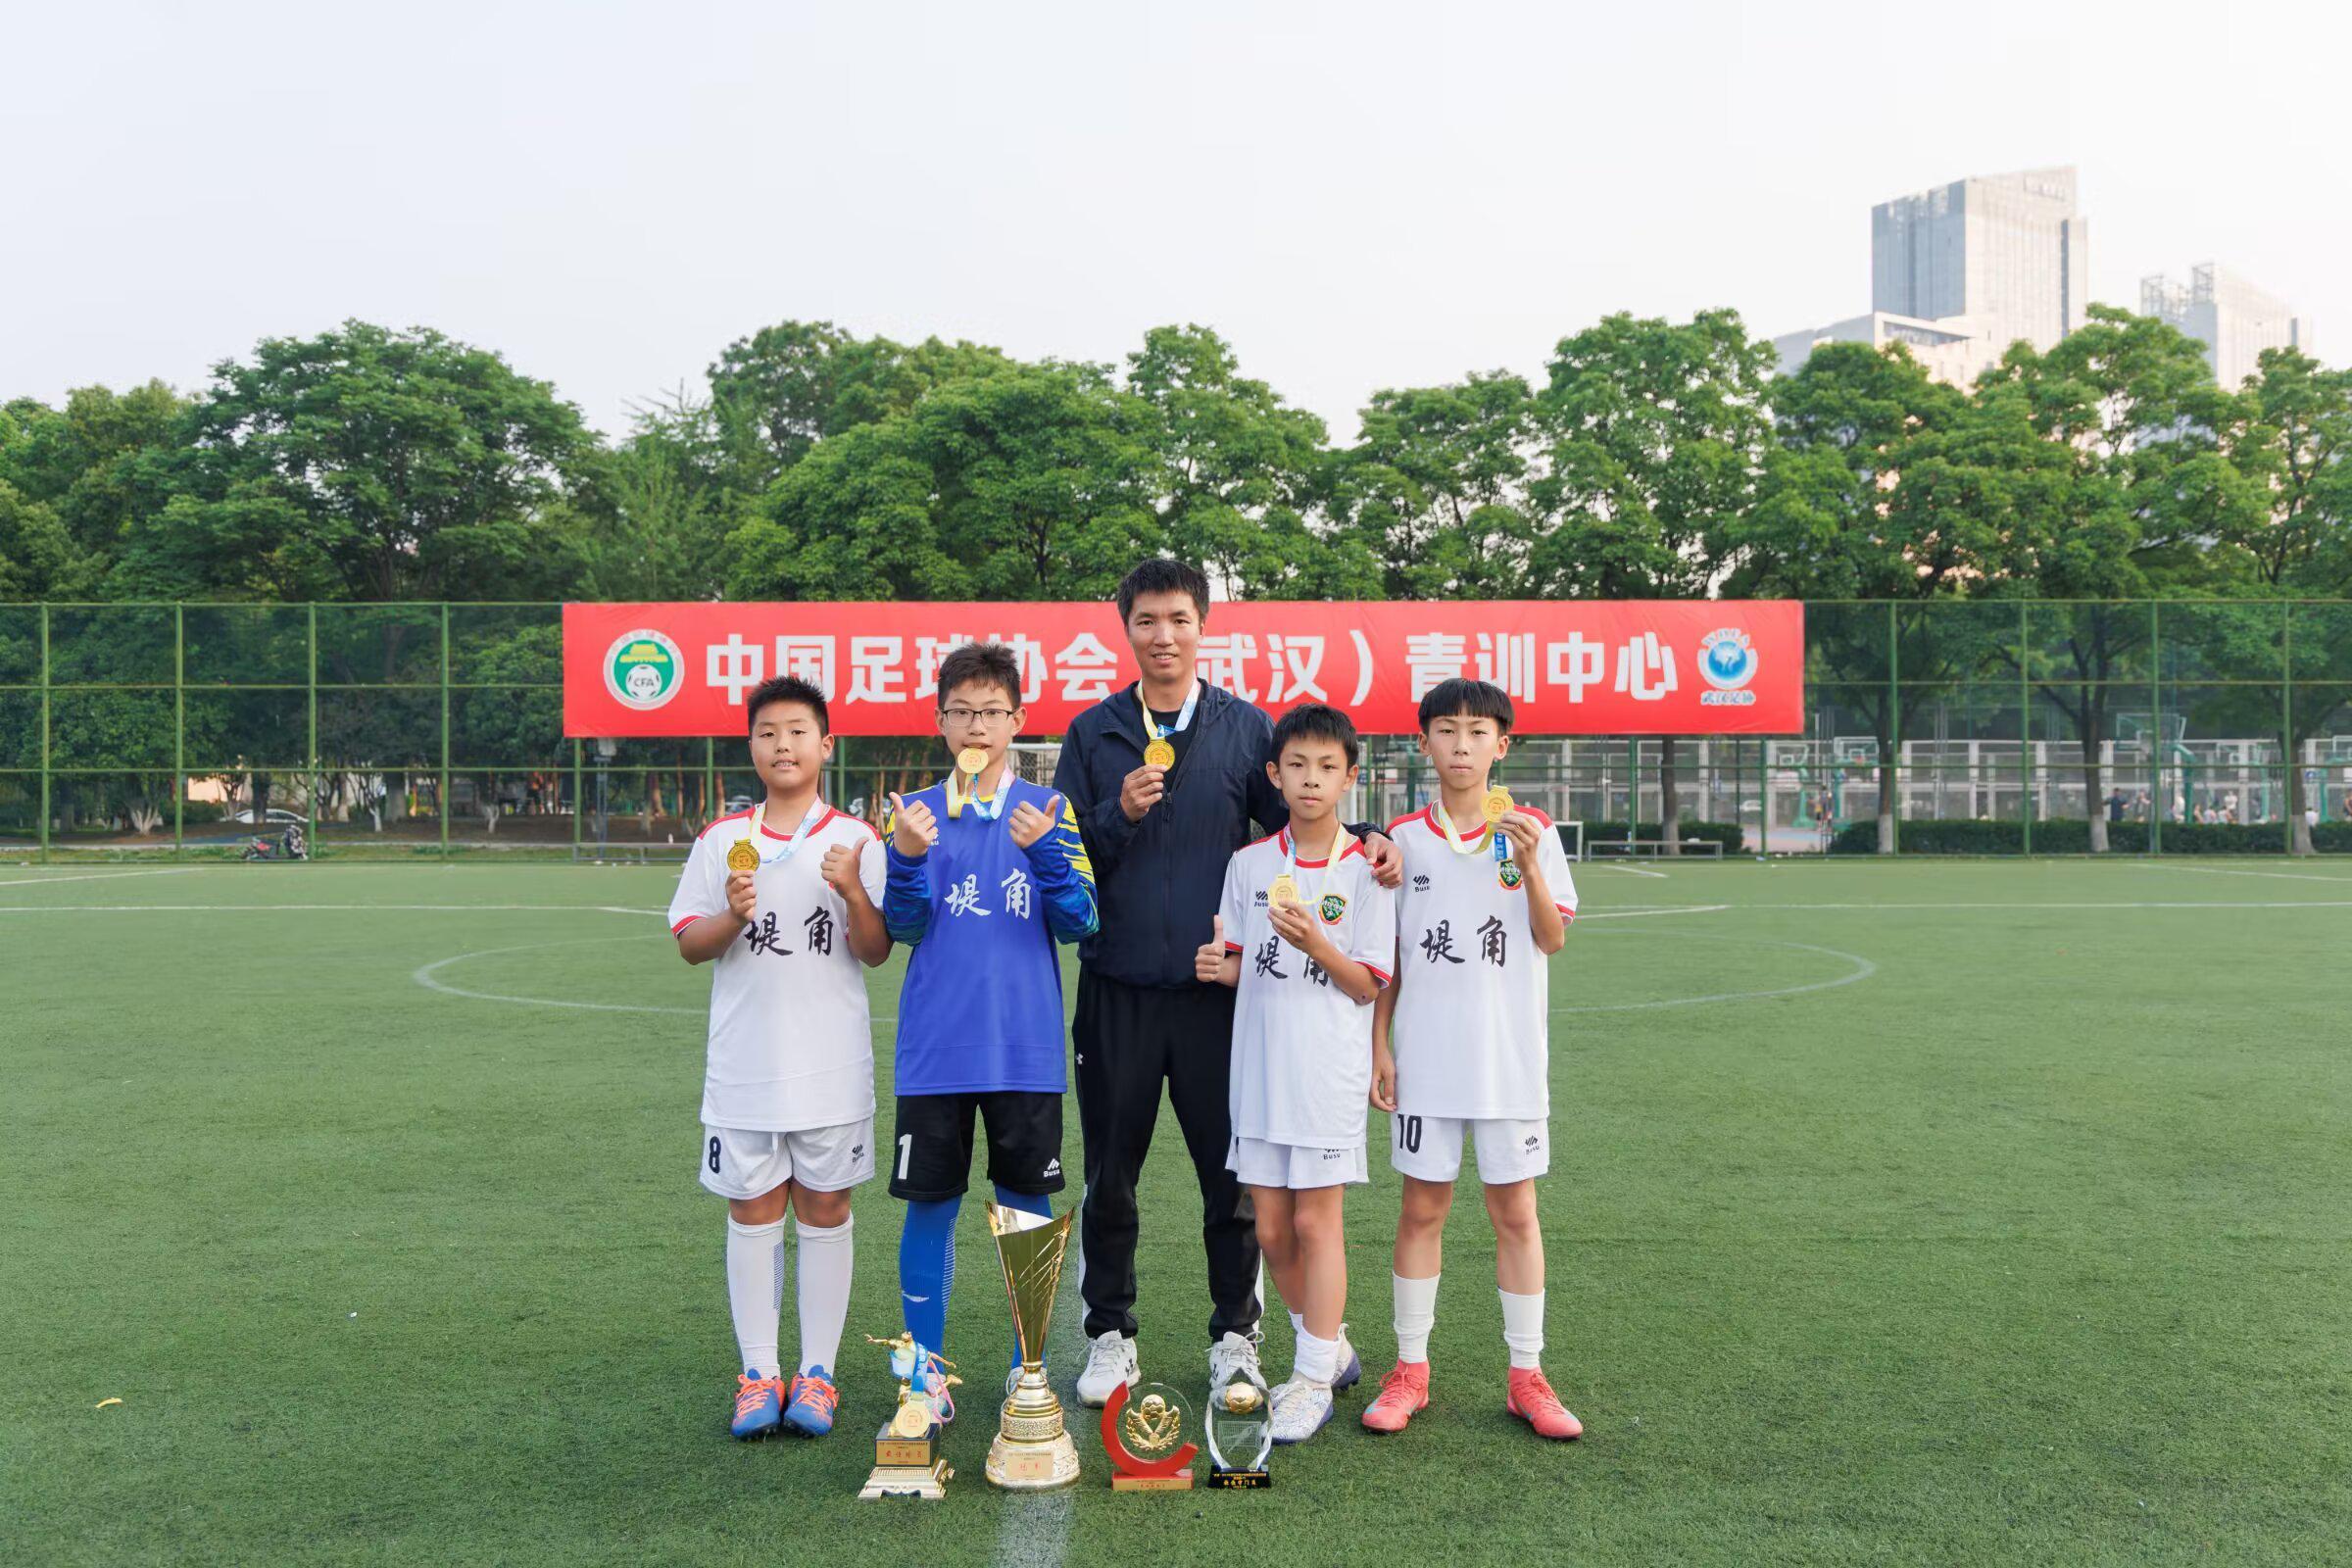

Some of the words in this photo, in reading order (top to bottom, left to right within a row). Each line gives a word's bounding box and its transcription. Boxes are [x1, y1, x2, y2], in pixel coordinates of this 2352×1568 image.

[633, 677, 655, 688] CFA
[945, 867, 1032, 920] 堤角
[744, 906, 835, 956] 堤角
[1420, 914, 1508, 968] 堤角
[709, 1135, 722, 1174] 8
[898, 1134, 912, 1180] 1
[1397, 1114, 1422, 1154] 10
